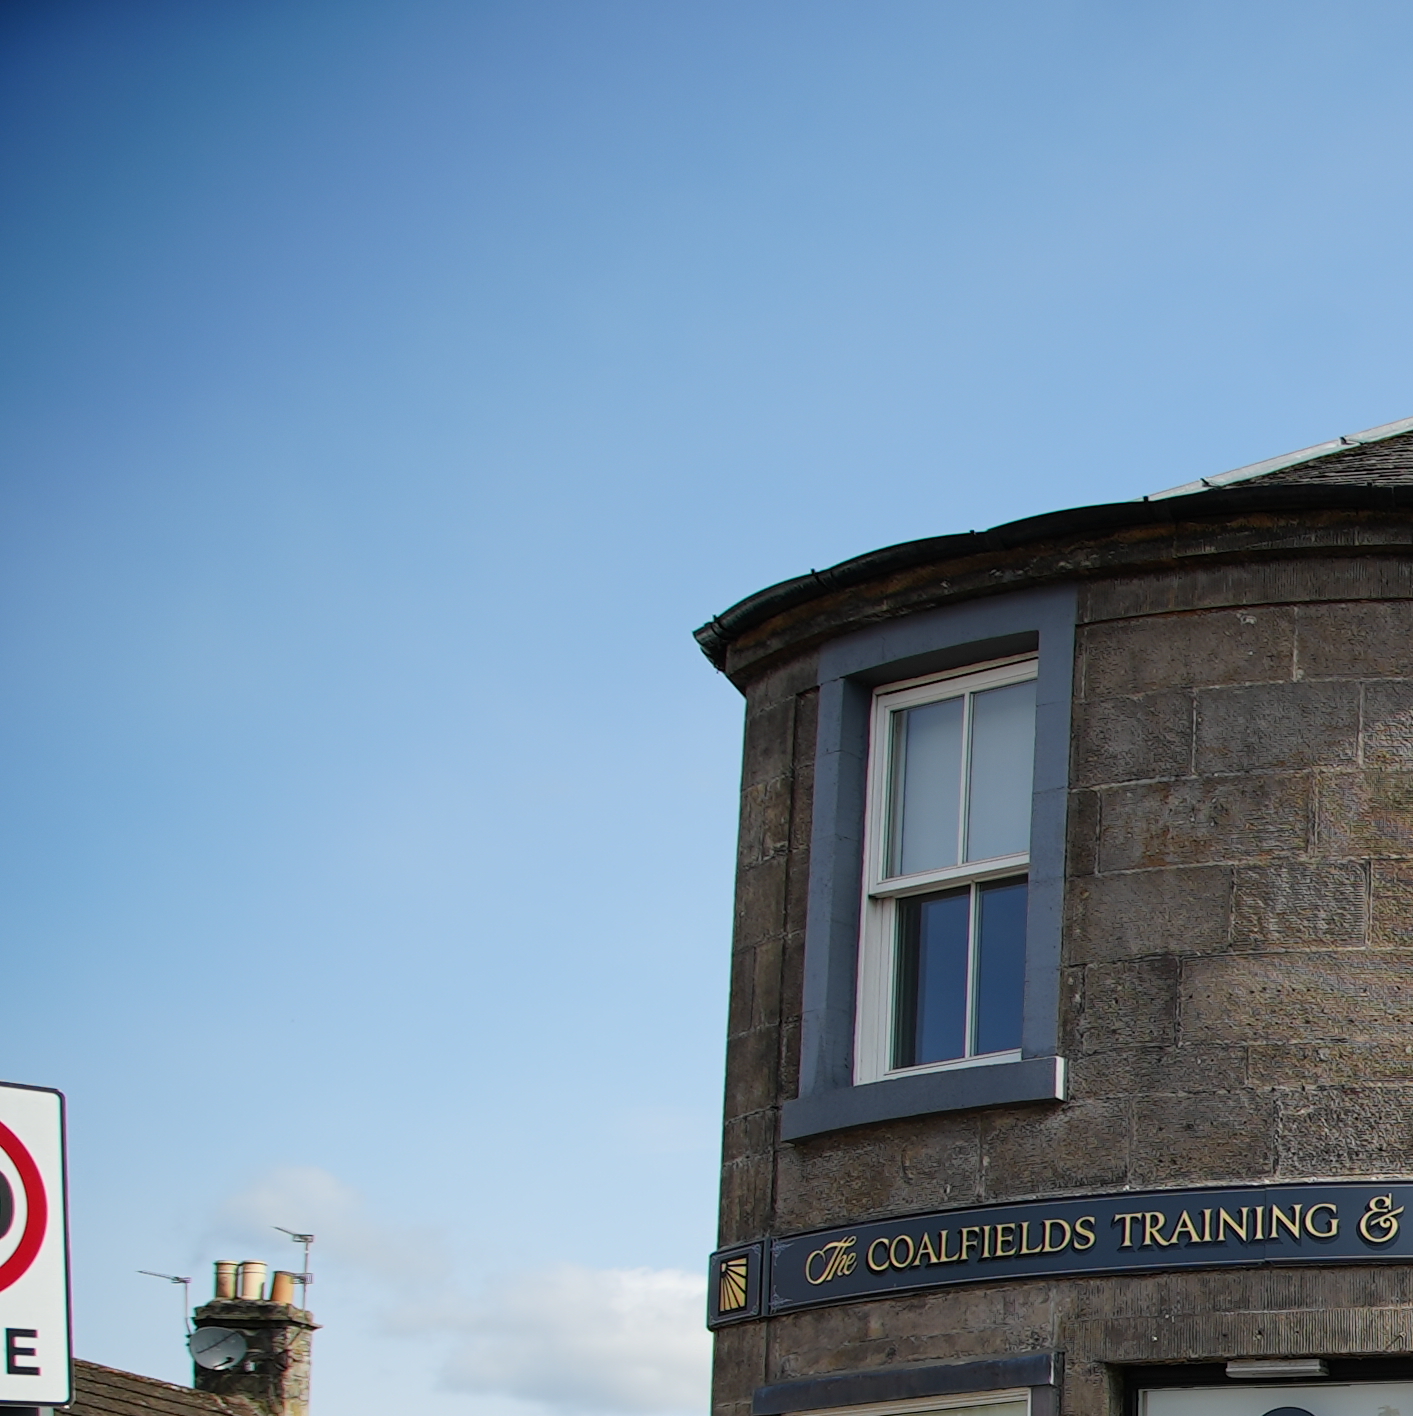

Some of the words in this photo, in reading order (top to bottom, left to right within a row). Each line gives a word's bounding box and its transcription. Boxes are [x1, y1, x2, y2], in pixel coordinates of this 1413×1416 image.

[804, 1235, 858, 1286] The
[866, 1214, 1098, 1272] COALFIELDS
[1113, 1202, 1341, 1248] TRAINING
[1358, 1192, 1406, 1244] &
